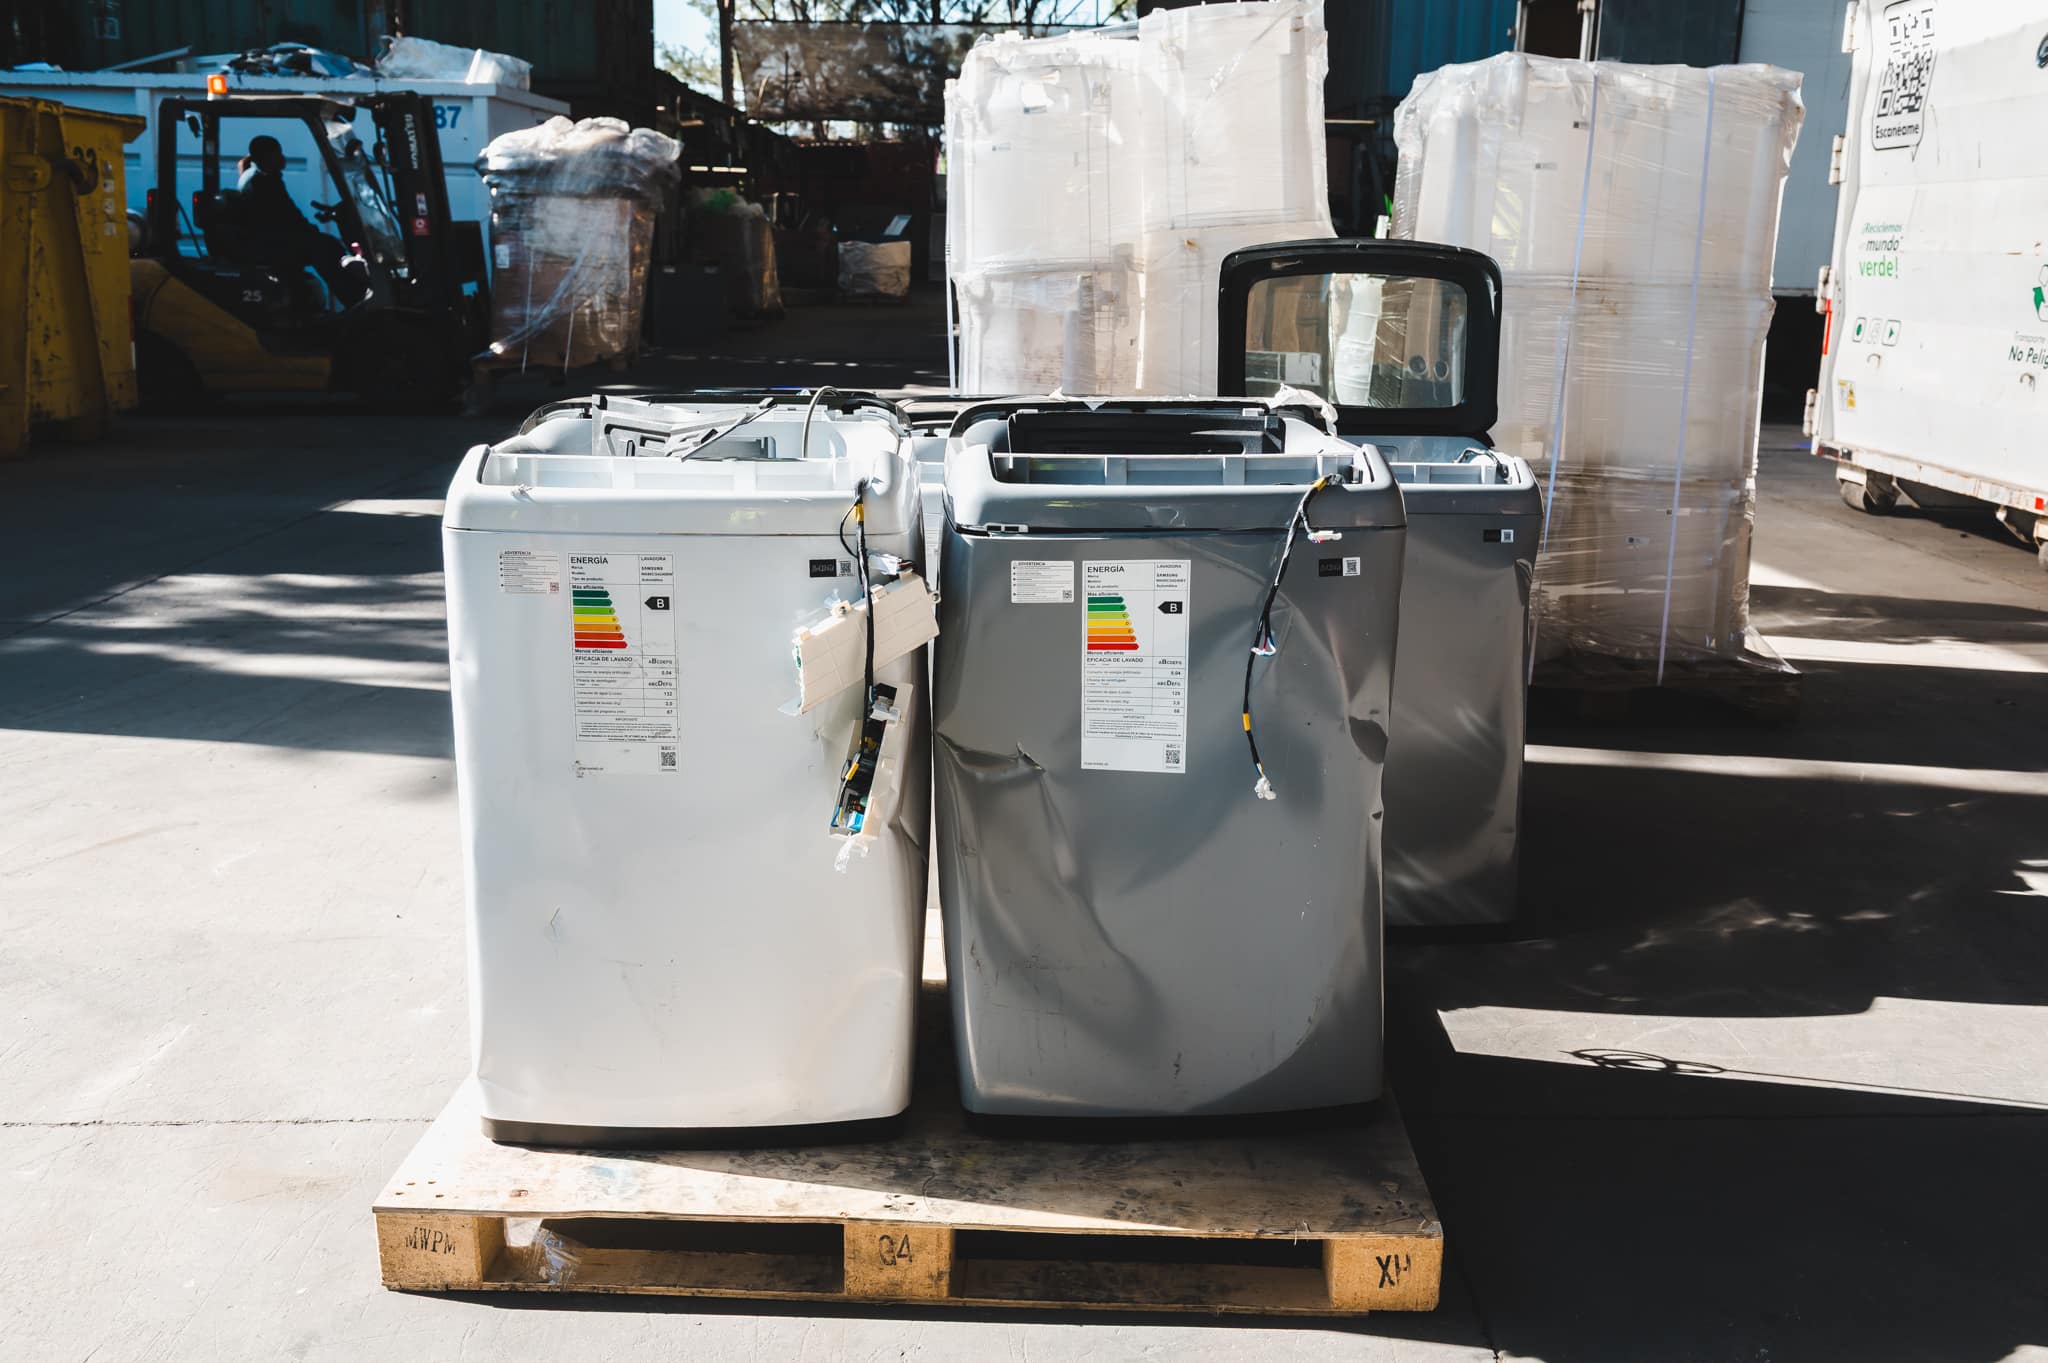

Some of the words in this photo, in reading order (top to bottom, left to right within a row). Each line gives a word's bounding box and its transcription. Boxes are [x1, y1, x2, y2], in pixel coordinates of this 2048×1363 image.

[403, 112, 419, 169] KOMATSU
[1866, 234, 1900, 251] mundo
[1858, 255, 1899, 279] verde!
[242, 289, 263, 302] 25
[2008, 345, 2024, 362] No
[1087, 565, 1125, 573] ENERGÍA
[656, 598, 665, 609] B
[1169, 603, 1178, 612] B
